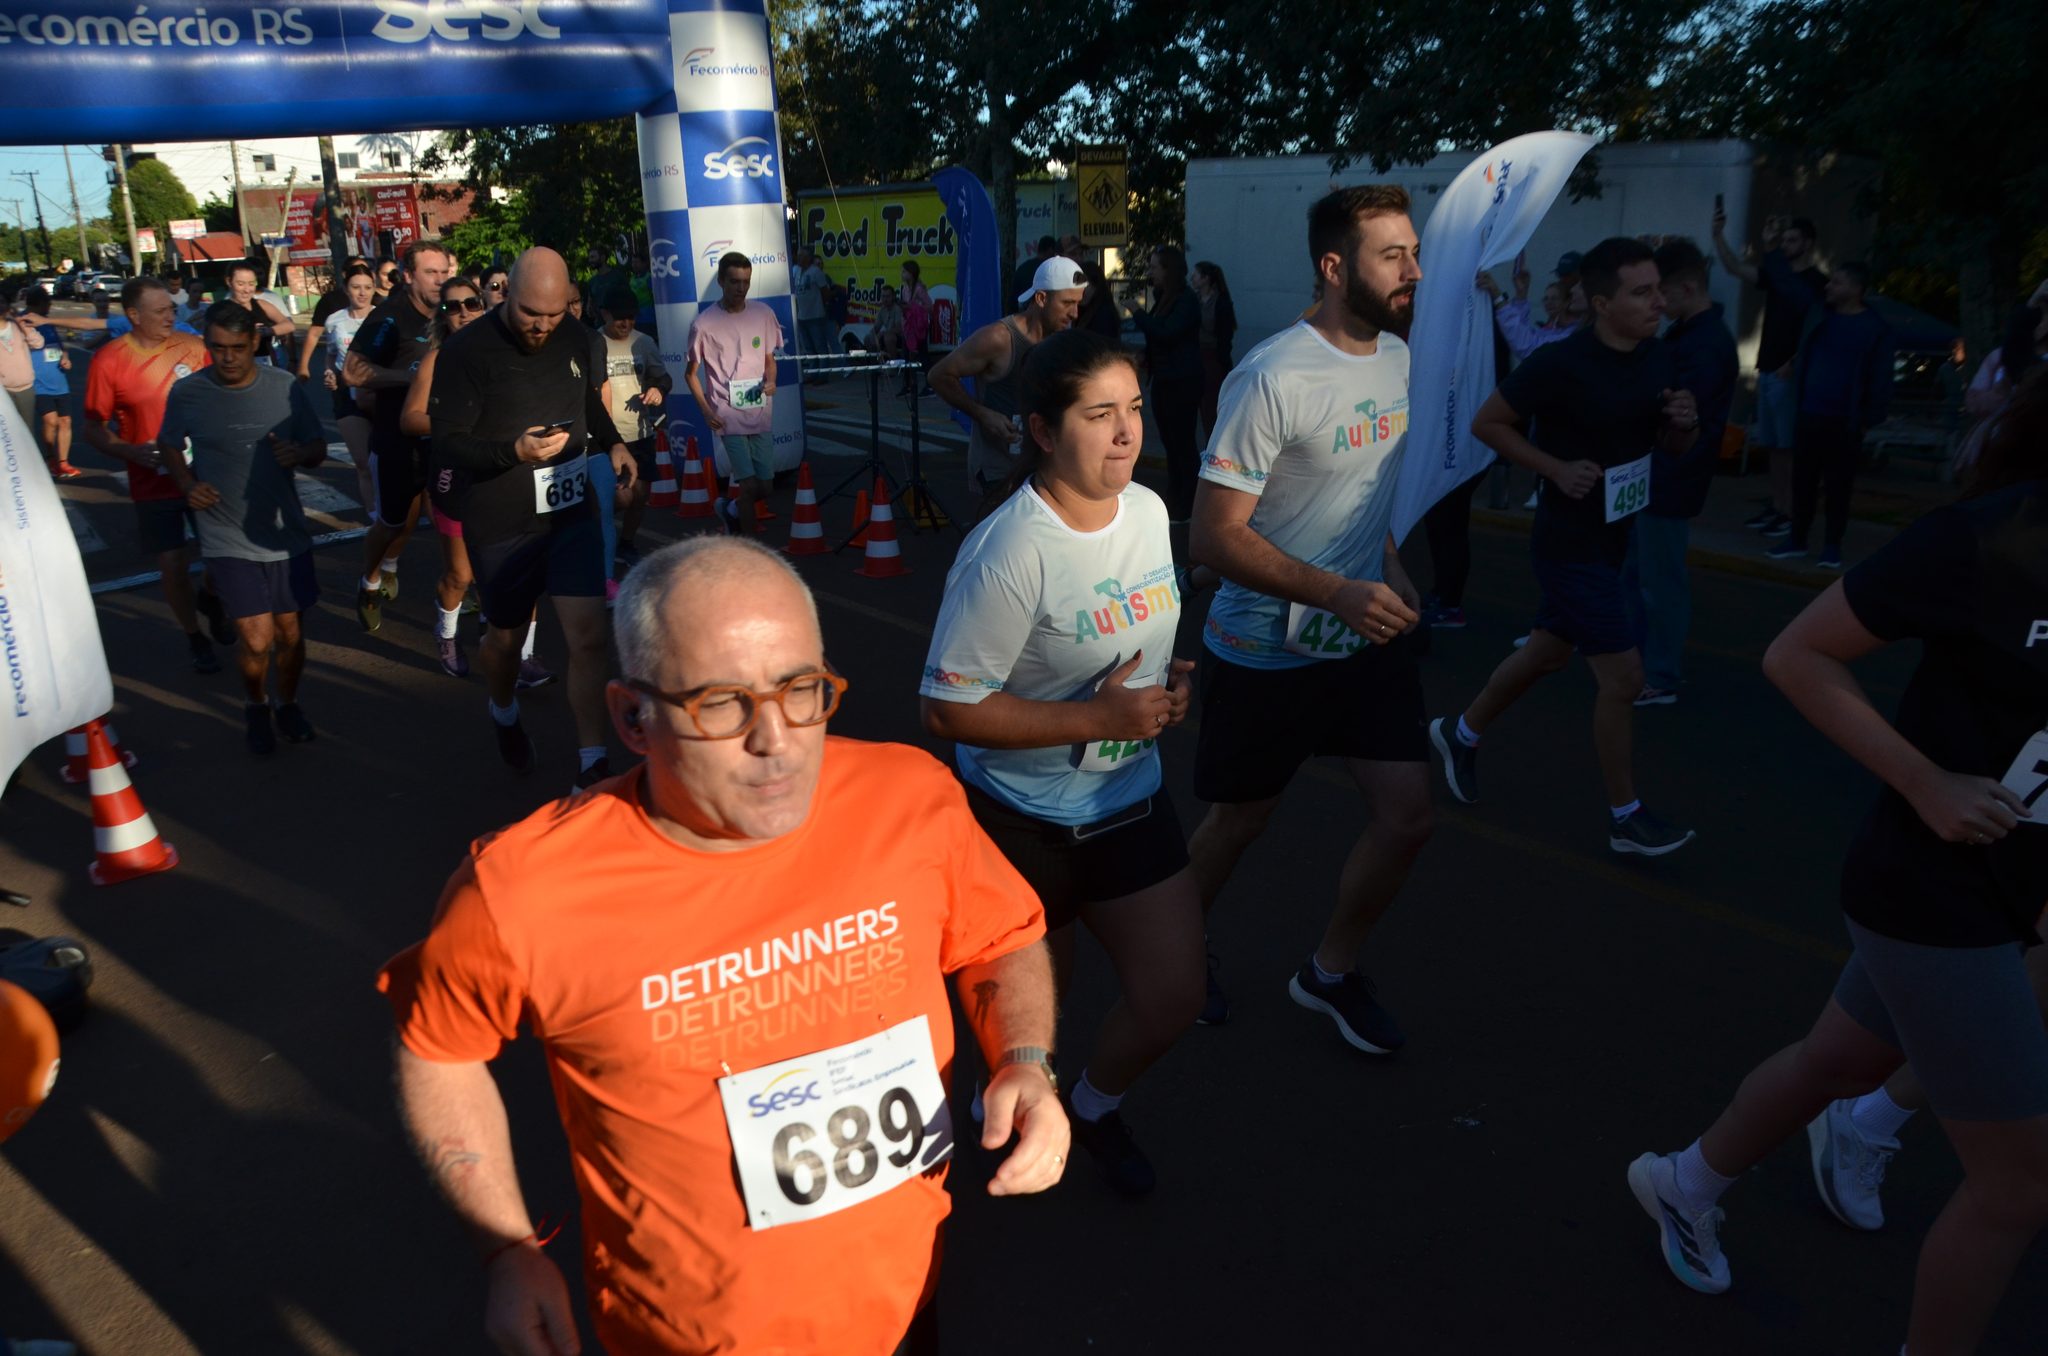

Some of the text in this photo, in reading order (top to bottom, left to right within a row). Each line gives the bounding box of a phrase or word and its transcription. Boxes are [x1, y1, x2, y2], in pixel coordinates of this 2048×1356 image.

[252, 8, 314, 46] RS
[689, 62, 758, 77] Fecomércio
[664, 164, 679, 177] RS
[1080, 150, 1123, 160] DEVAGAR
[807, 206, 869, 258] Food
[882, 204, 955, 257] Truck
[1083, 222, 1125, 236] ELEVADA
[736, 389, 763, 407] 348
[10, 475, 30, 530] Sistema
[546, 472, 585, 508] 683
[1613, 478, 1646, 514] 499
[641, 901, 900, 1010] DETRUNNERS
[650, 935, 906, 1043] DETRUNNERS
[771, 1087, 926, 1207] 689
